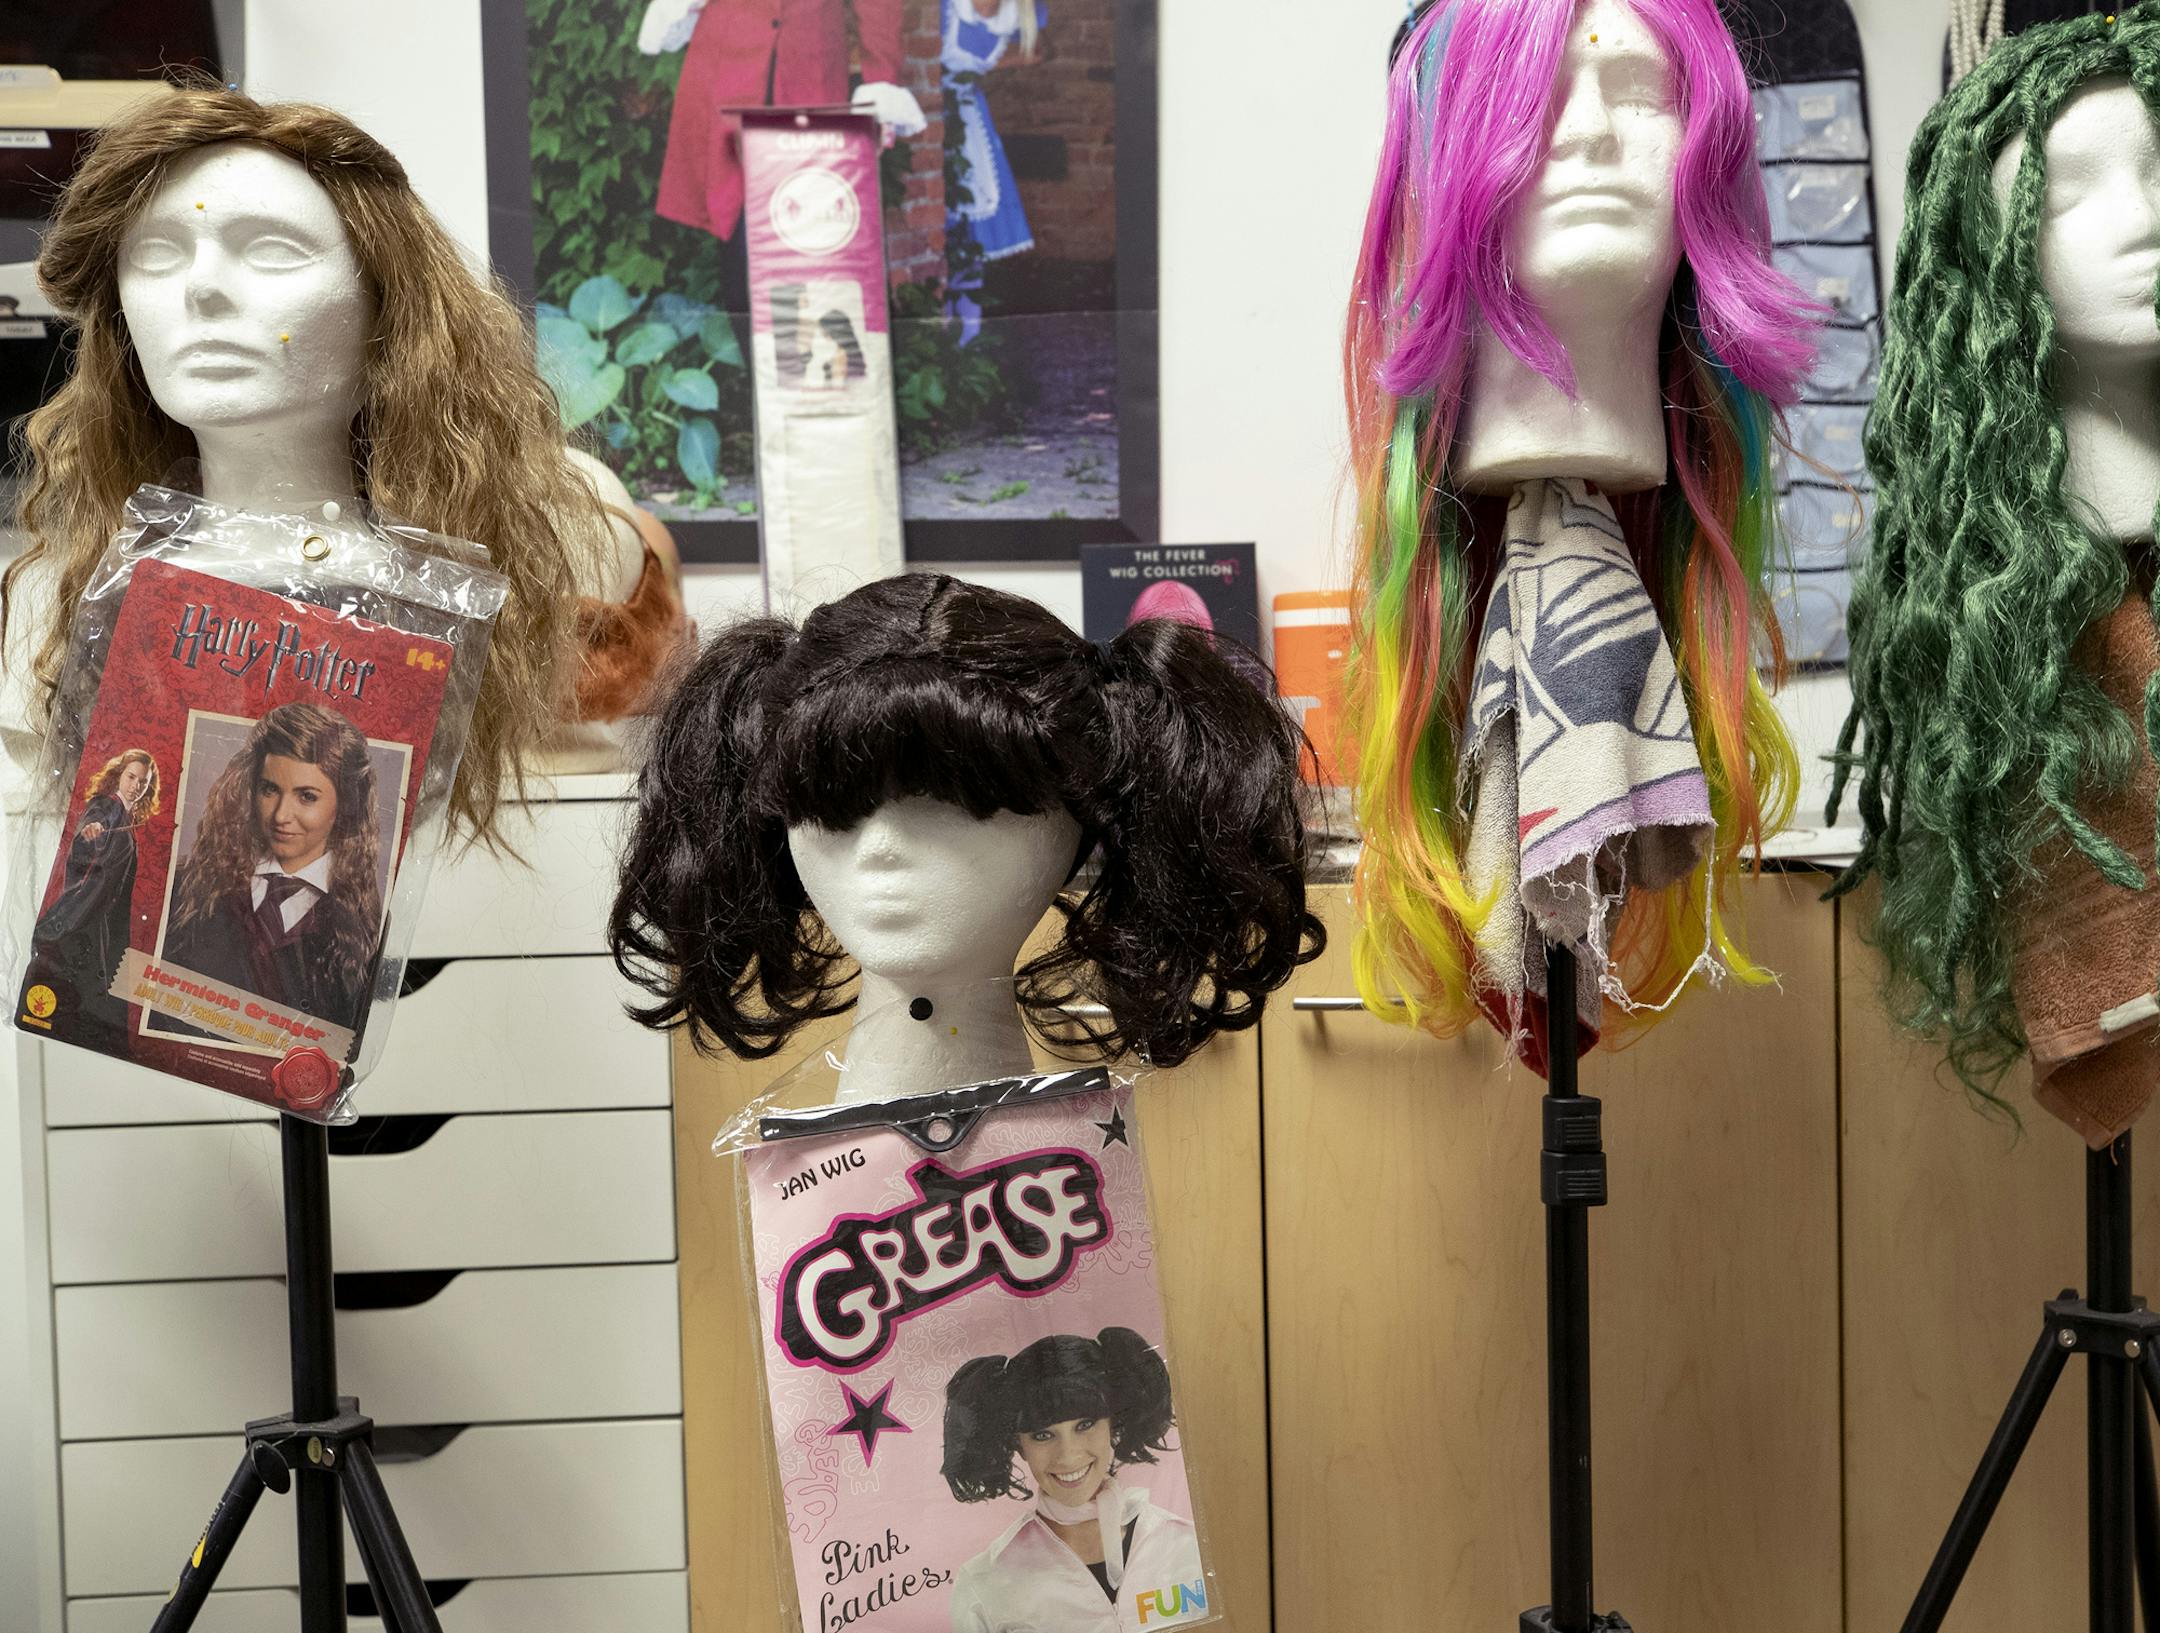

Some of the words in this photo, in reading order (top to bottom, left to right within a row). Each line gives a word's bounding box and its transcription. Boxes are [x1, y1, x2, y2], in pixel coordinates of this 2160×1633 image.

[1109, 566, 1138, 578] WIG
[1143, 564, 1233, 578] COLLECTION
[1135, 550, 1160, 561] THE
[1165, 549, 1206, 560] FEVER
[171, 603, 270, 678] Harry
[264, 619, 376, 701] Potter
[406, 648, 446, 672] 14+
[143, 964, 240, 1011] Hermione
[244, 1001, 327, 1042] Granger
[780, 1168, 818, 1201] JAN
[820, 1148, 866, 1180] WIG
[796, 1164, 1100, 1359] GREASE
[821, 1528, 910, 1586] Pink
[820, 1567, 951, 1633] Ladies
[1135, 1579, 1206, 1625] FUN
